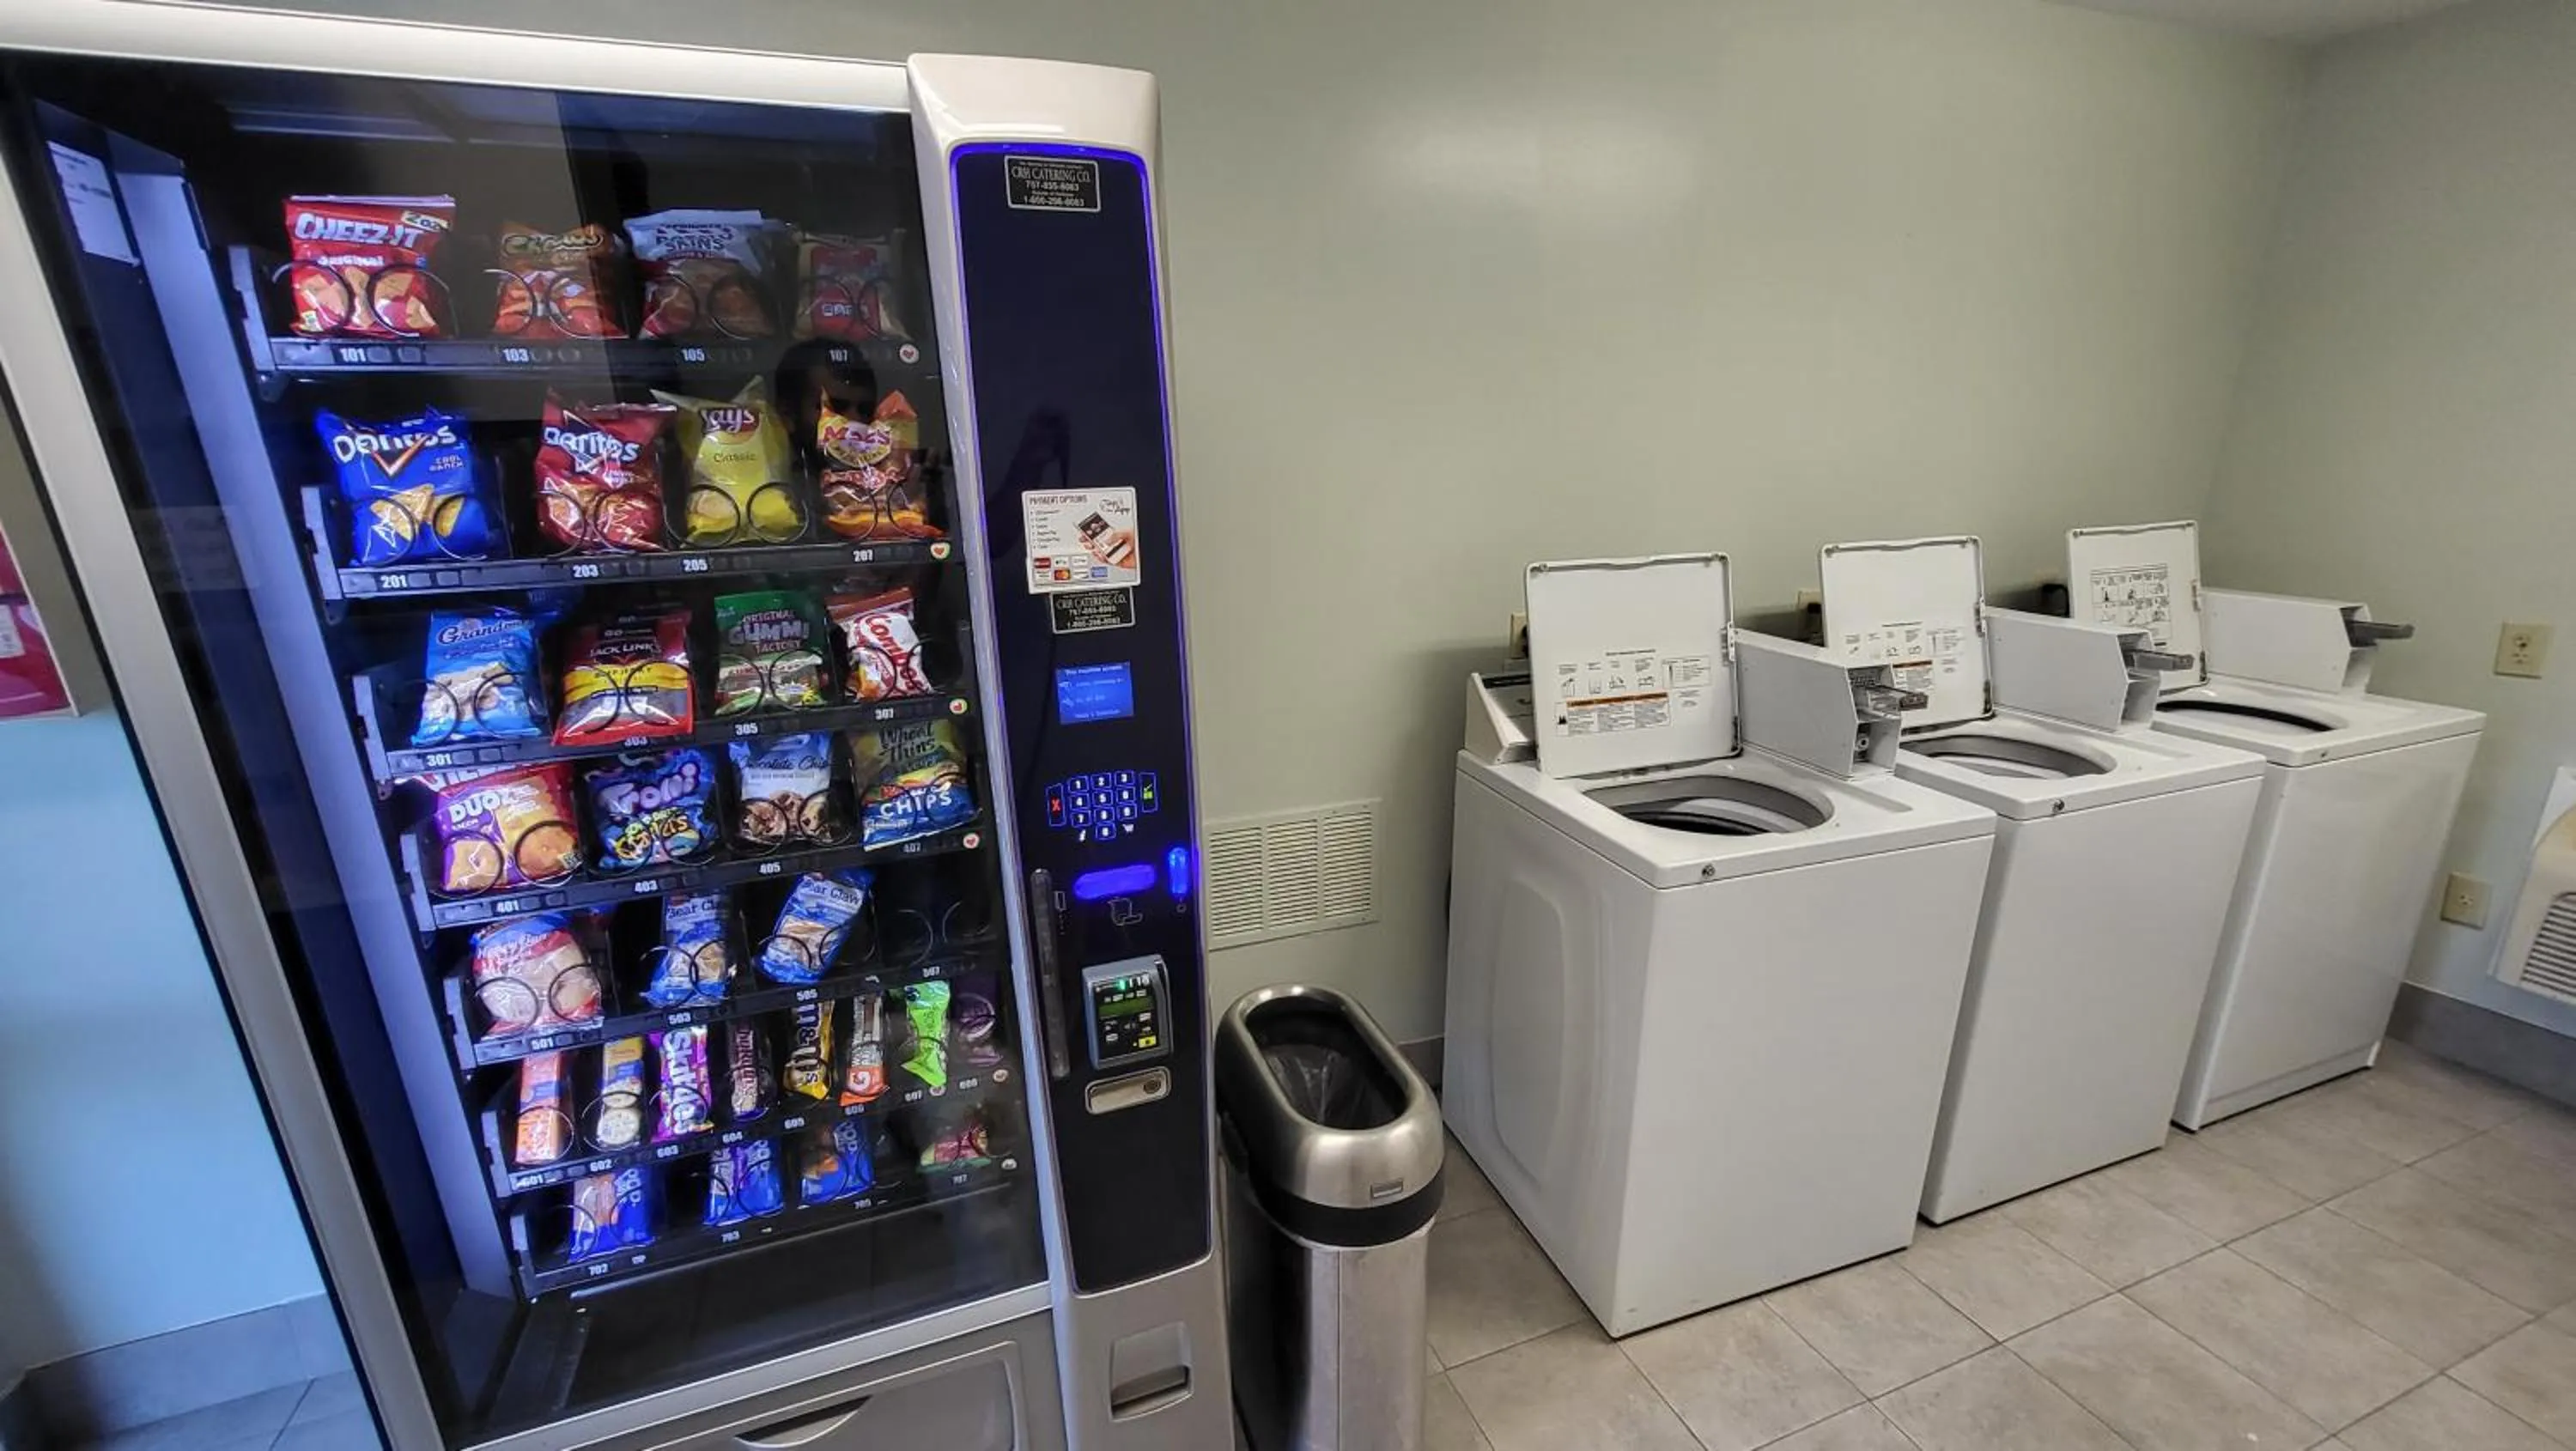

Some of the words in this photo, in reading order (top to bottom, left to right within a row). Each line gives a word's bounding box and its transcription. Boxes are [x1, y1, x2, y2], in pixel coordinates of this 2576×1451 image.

[1032, 167, 1076, 182] CATERING
[295, 212, 425, 248] CHEEZ-IT
[665, 238, 726, 252] SKINS
[343, 348, 367, 362] 101
[502, 348, 529, 363] 103
[681, 349, 706, 362] 105
[573, 563, 598, 579] 203
[683, 558, 708, 573] 205
[381, 574, 409, 590] 201
[1074, 595, 1114, 609] CATERING
[875, 707, 895, 719] 307
[734, 723, 758, 736] 305
[426, 754, 453, 767] 301
[1075, 780, 1082, 790] 1
[1098, 776, 1105, 786] 2
[1121, 774, 1127, 784] 3
[1075, 796, 1084, 806] 4
[1099, 793, 1107, 804] 5
[1122, 791, 1129, 800] 6
[879, 790, 952, 817] CHIPS
[1102, 810, 1109, 820] 8
[1123, 807, 1131, 817] 9
[1078, 814, 1084, 824] 7
[1102, 827, 1109, 837] 0
[759, 862, 781, 875] 405
[634, 880, 658, 894] 403
[829, 886, 860, 906] Claw
[496, 900, 519, 914] 401
[796, 988, 818, 1002] 505
[666, 1012, 691, 1025] 503
[531, 1037, 554, 1051] 501
[662, 1030, 693, 1135] Skittles
[721, 1132, 744, 1144] 604
[657, 1144, 678, 1158] 603
[590, 1159, 611, 1172] 602
[522, 1175, 544, 1187] 601
